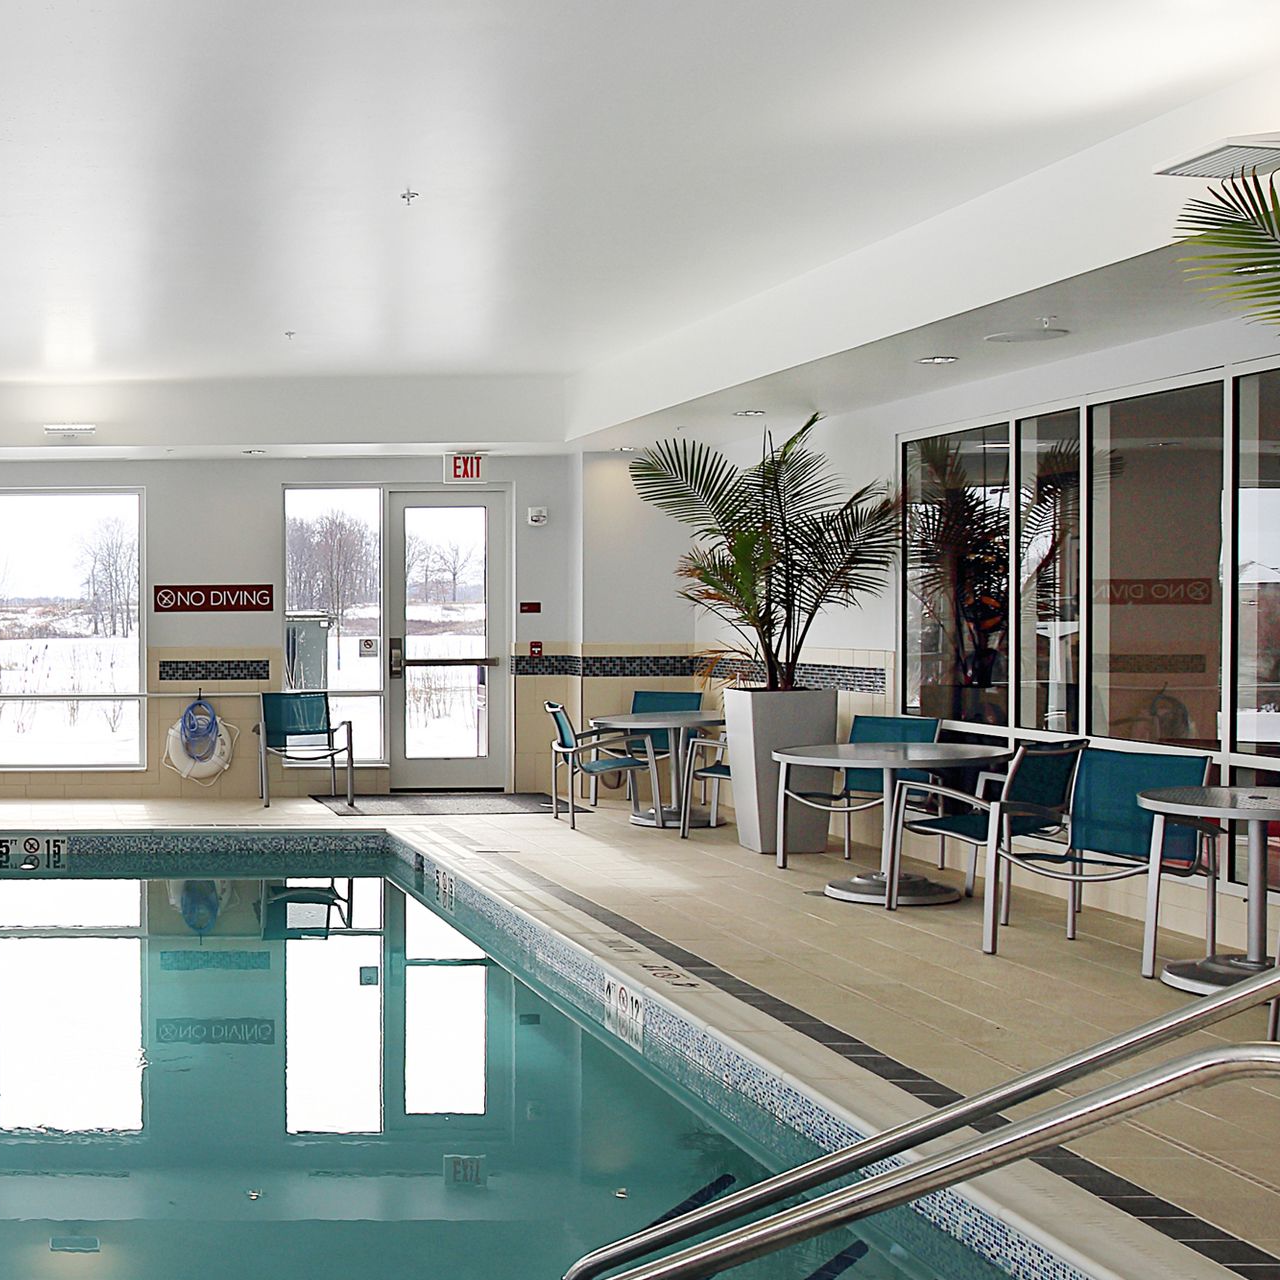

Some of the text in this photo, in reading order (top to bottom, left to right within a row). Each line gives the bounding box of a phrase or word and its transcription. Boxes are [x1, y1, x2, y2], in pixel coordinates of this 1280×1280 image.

[453, 456, 482, 478] EXIT
[177, 590, 270, 606] NO DIVING
